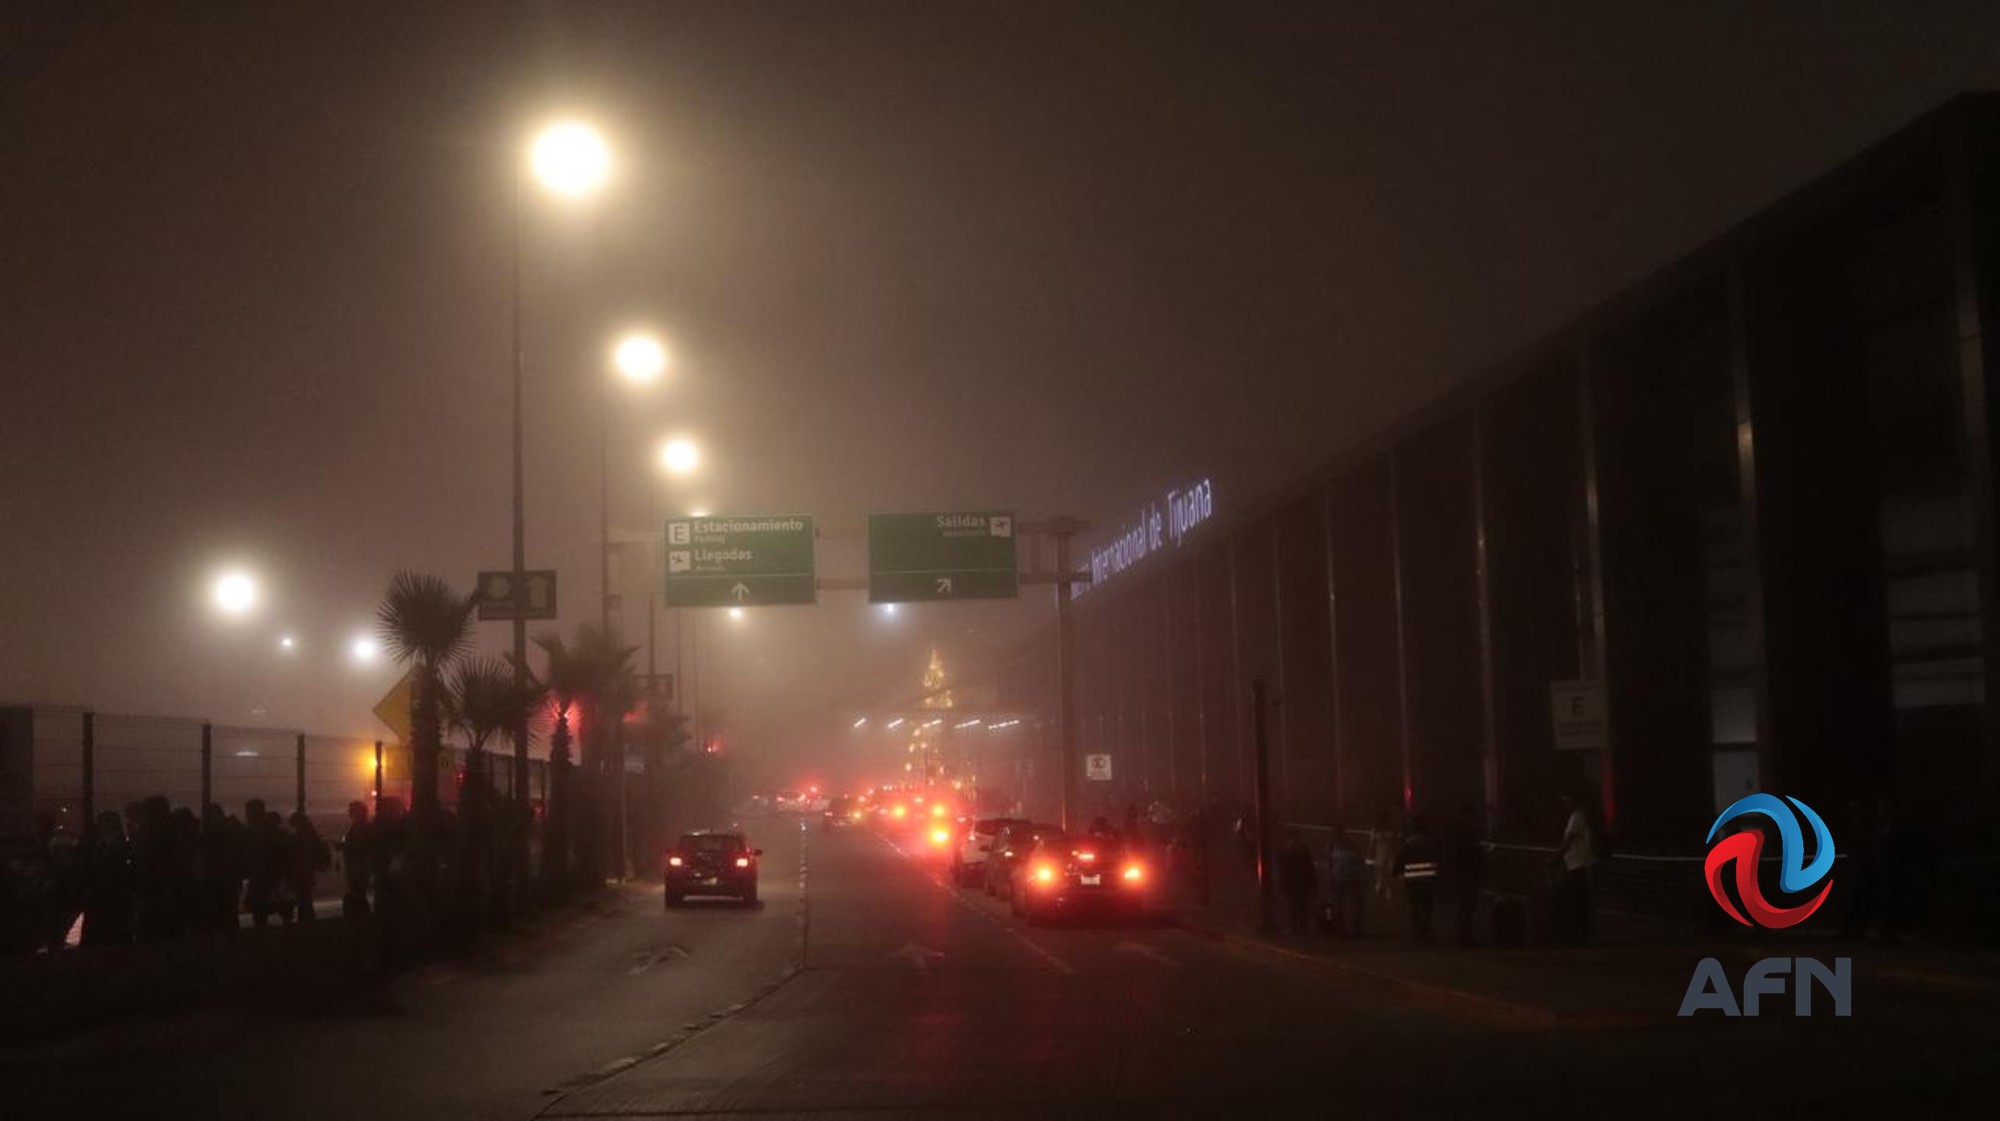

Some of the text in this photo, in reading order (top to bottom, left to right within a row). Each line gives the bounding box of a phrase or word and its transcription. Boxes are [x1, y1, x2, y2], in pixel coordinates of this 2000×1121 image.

[937, 514, 986, 527] Salidas
[1149, 502, 1162, 550] de
[1167, 478, 1211, 548] Tijuana
[674, 519, 803, 542] E Estacionamiento
[695, 549, 752, 563] Llegadas
[1572, 697, 1584, 714] E
